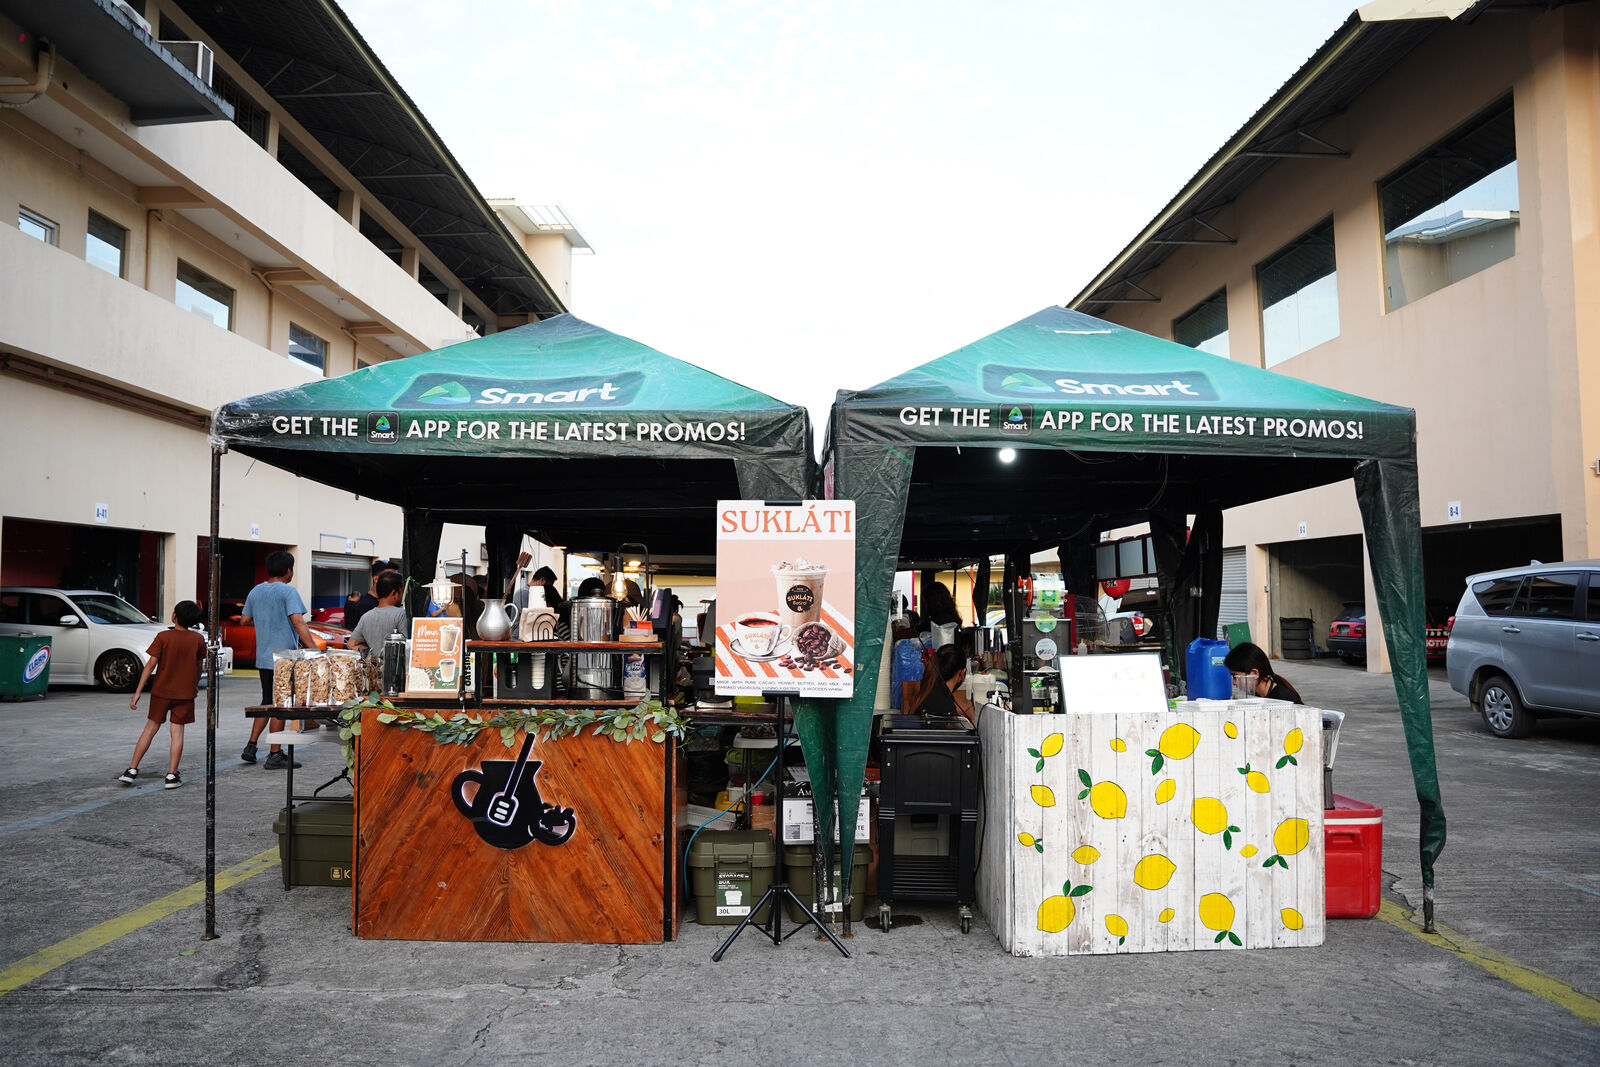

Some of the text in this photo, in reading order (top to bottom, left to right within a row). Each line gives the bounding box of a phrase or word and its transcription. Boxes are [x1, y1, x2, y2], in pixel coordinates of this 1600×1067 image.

[476, 382, 620, 404] Smart
[1055, 378, 1200, 396] Smart
[272, 416, 358, 436] GET THE
[899, 406, 991, 428] GET THE
[1003, 421, 1028, 431] Smart
[1039, 410, 1364, 440] APP FOR THE LATEST PROMOS!
[370, 430, 395, 439] Smart
[406, 419, 746, 443] APP FOR THE LATEST PROMOS!
[721, 505, 852, 533] SUKLÁTI
